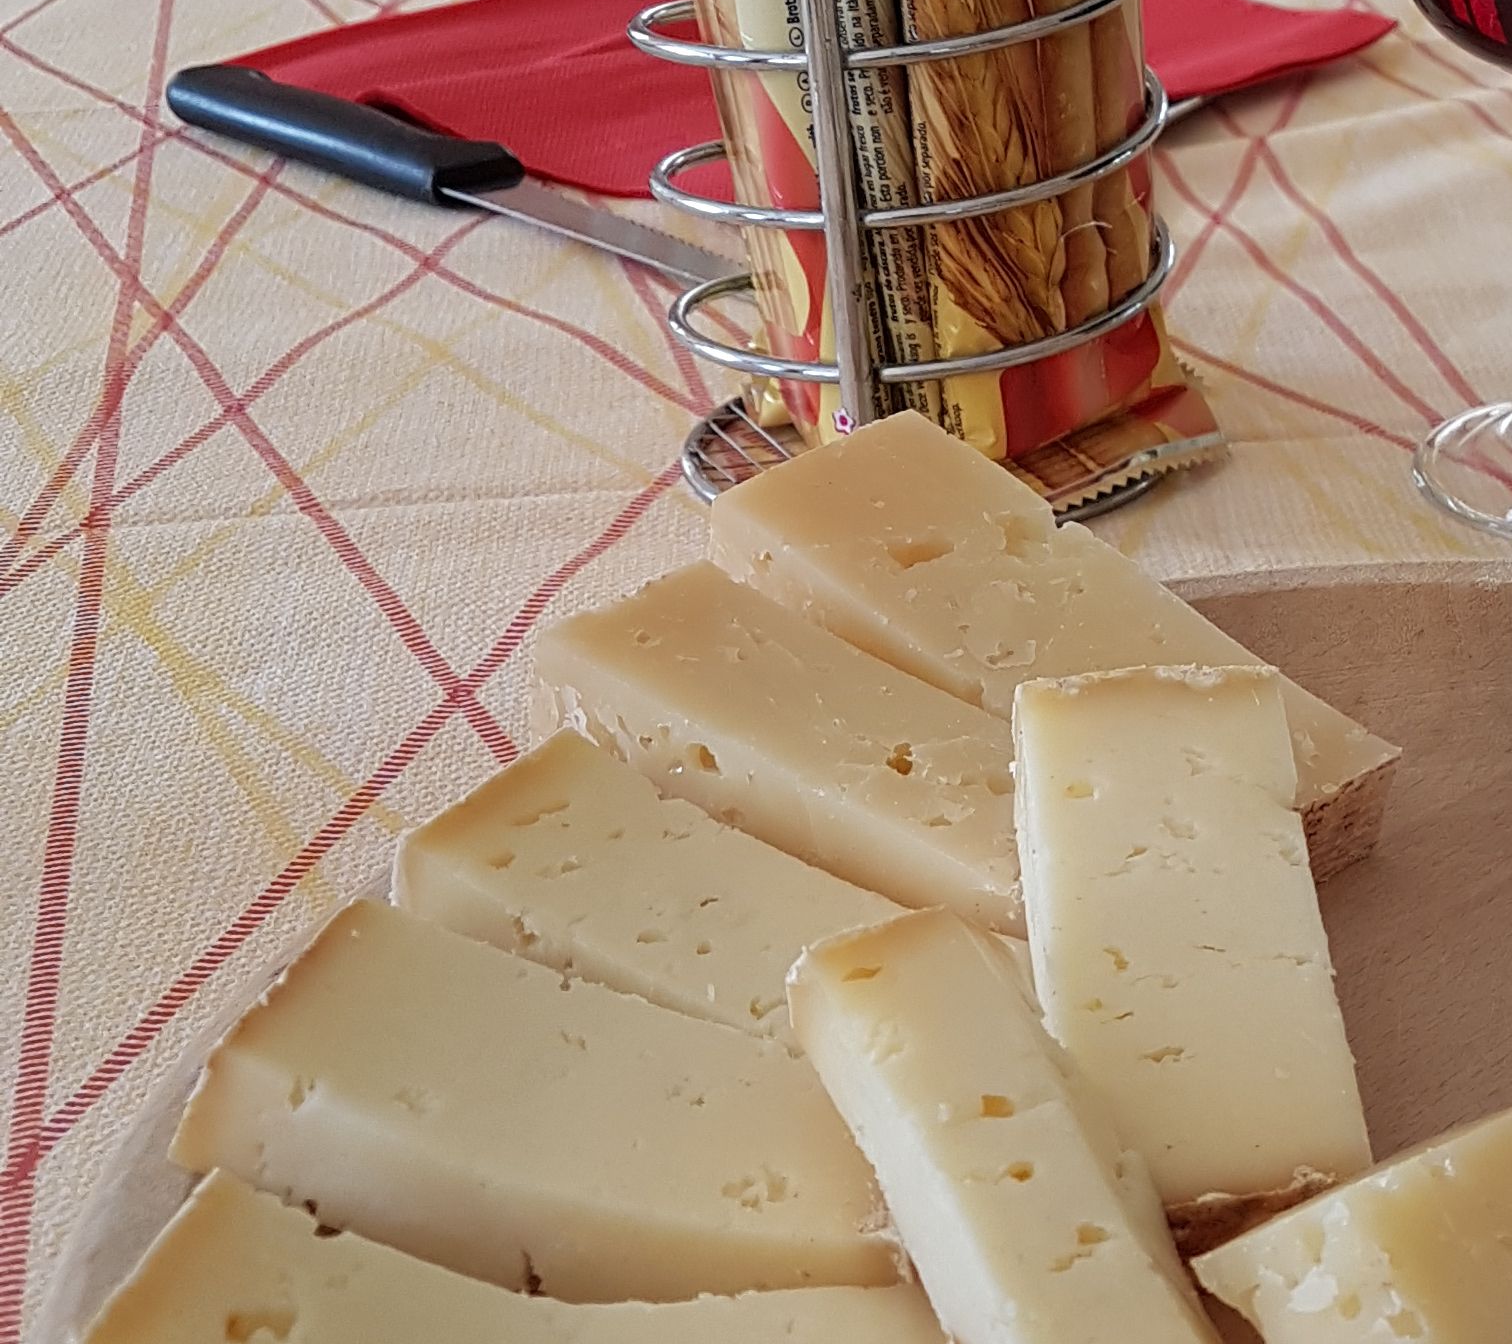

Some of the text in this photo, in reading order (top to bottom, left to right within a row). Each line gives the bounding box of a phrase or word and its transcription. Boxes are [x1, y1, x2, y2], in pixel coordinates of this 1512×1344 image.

[849, 16, 862, 28] na
[861, 82, 878, 107] seco.
[854, 124, 869, 153] fresco
[860, 154, 877, 178] lugar
[876, 184, 892, 202] Esta
